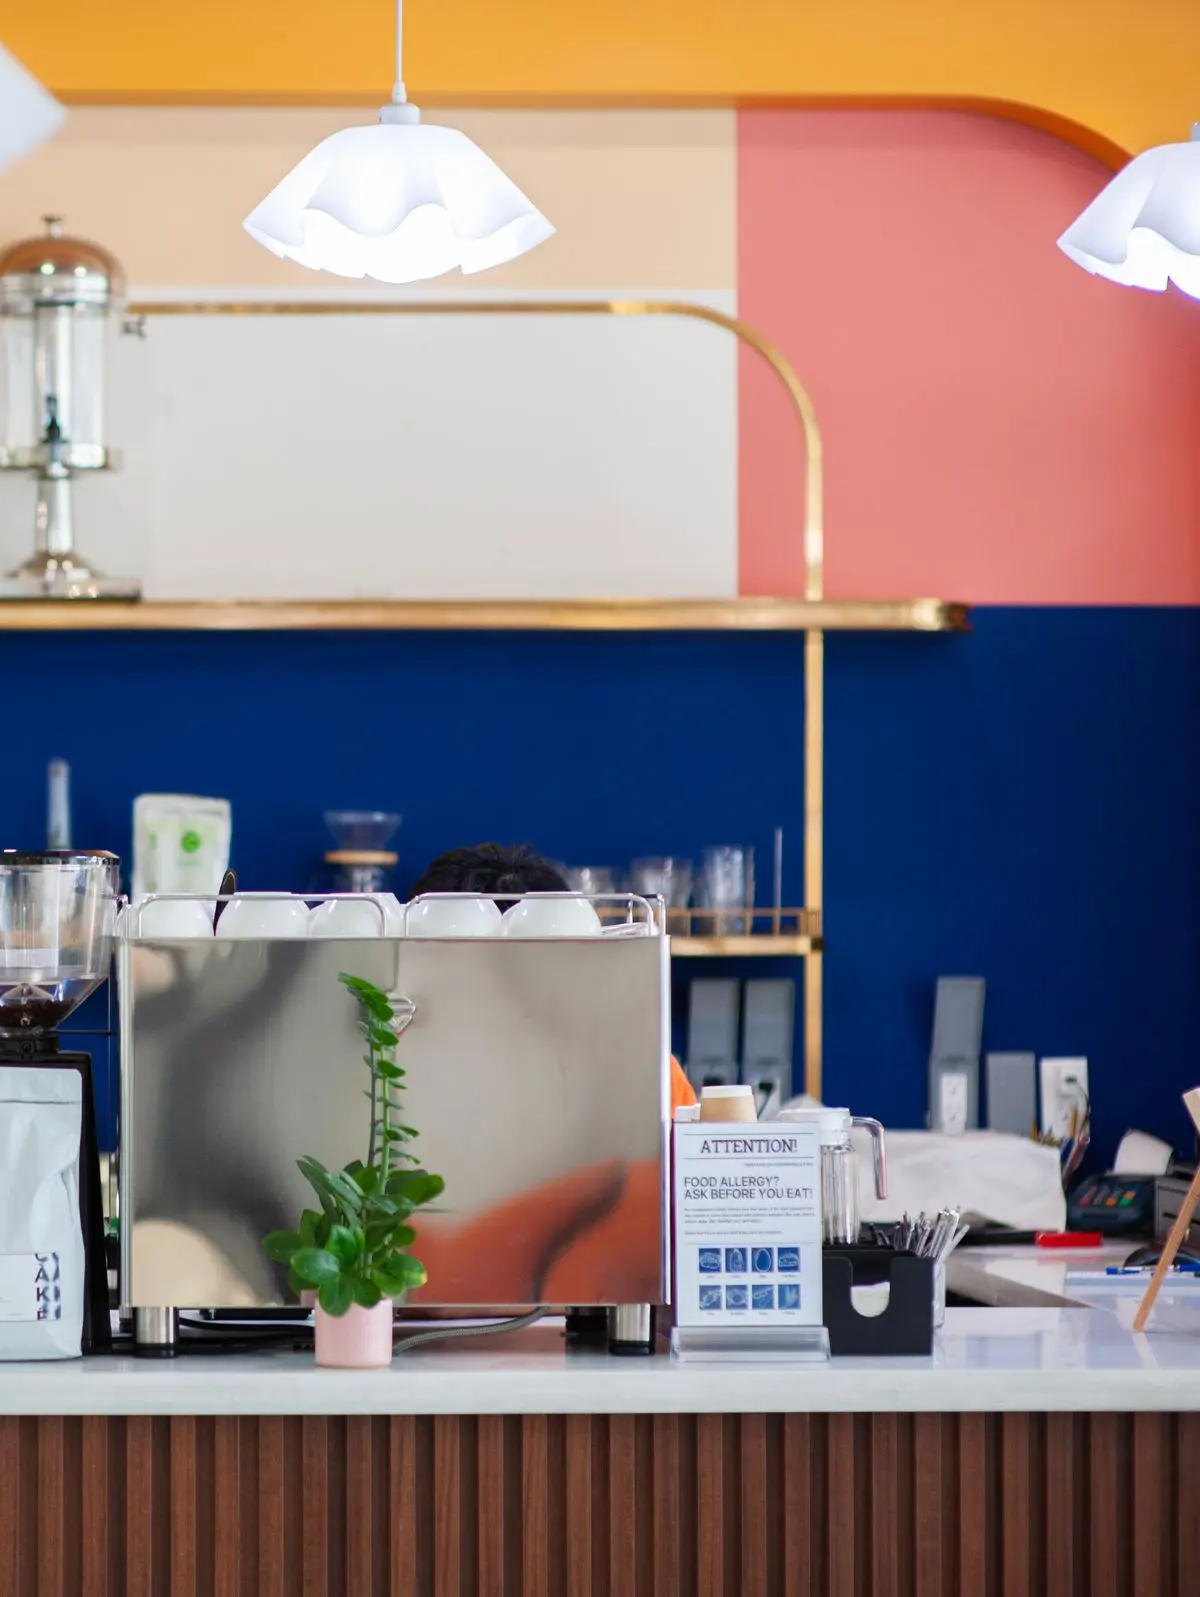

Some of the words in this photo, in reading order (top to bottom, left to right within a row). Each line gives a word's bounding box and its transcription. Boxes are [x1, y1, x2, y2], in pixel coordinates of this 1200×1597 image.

[700, 1138, 798, 1154] ATTENTION!
[684, 1176, 718, 1188] FOOD
[720, 1175, 780, 1188] ALLERGY?
[684, 1188, 709, 1200] ASK
[710, 1187, 757, 1200] BEFORE
[759, 1187, 785, 1199] YOU
[786, 1187, 814, 1199] EAT!
